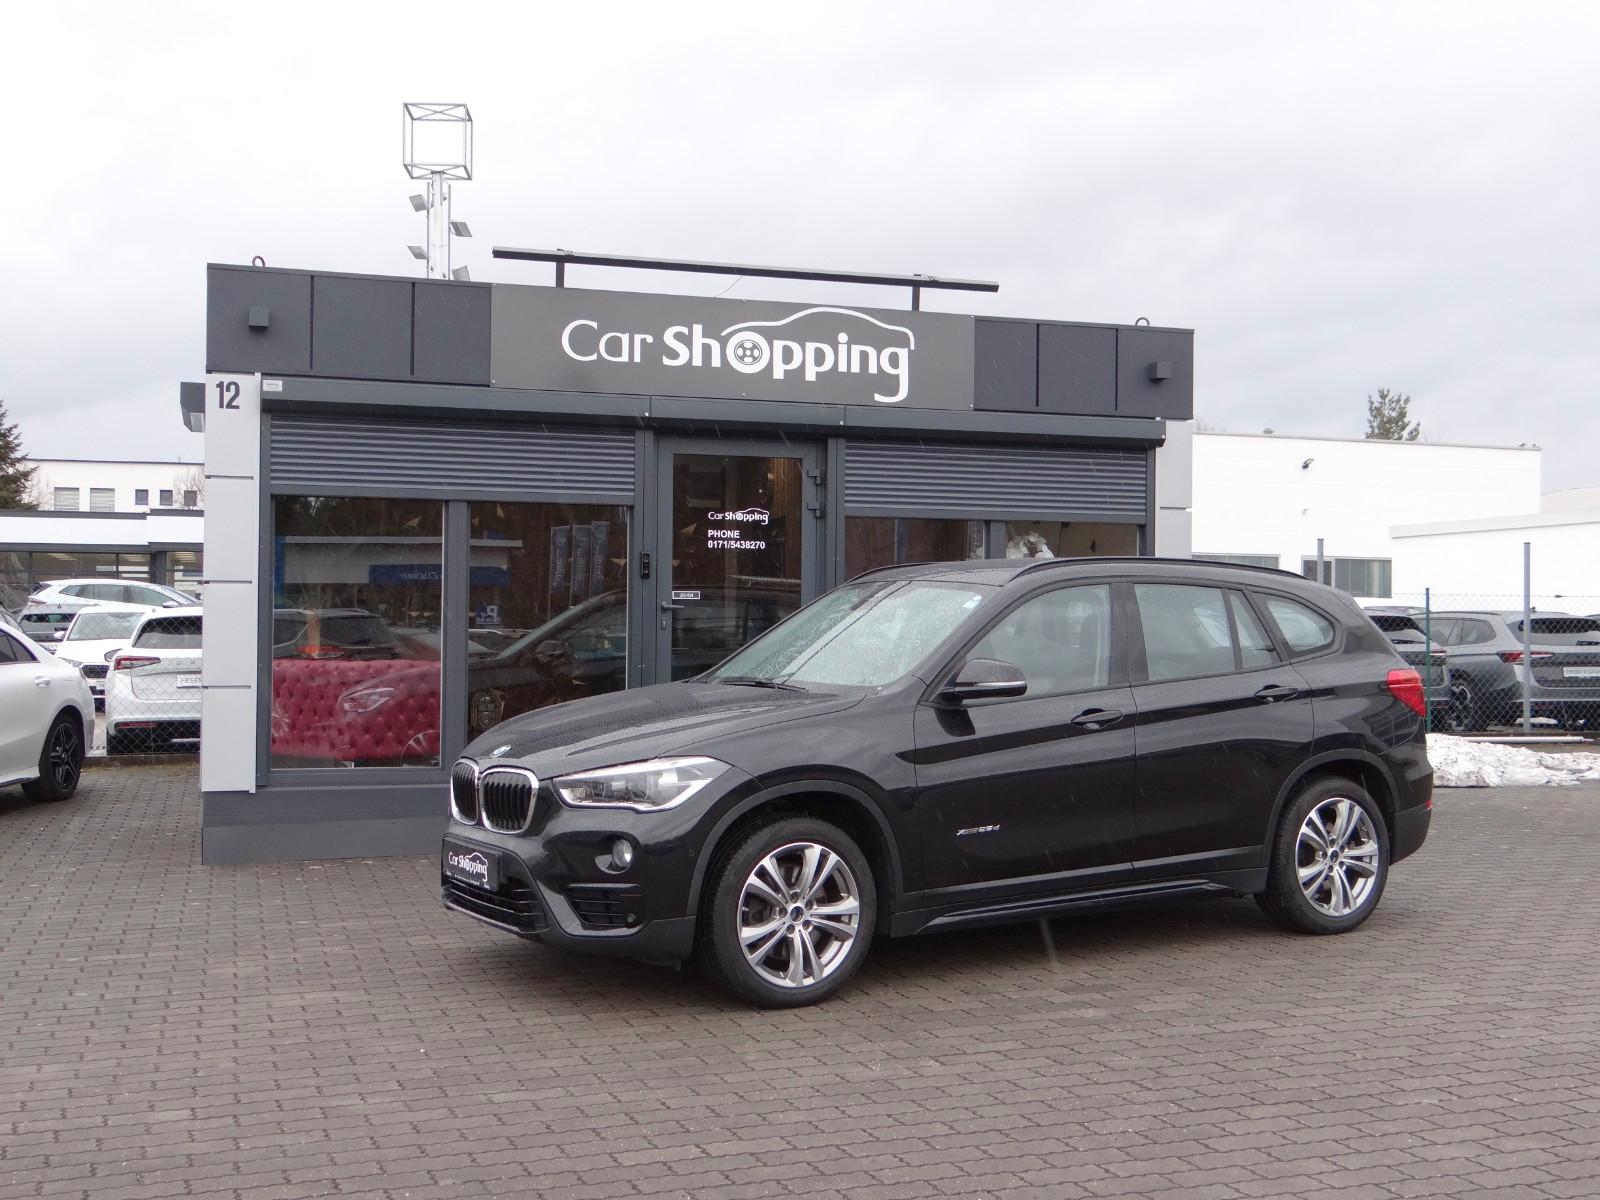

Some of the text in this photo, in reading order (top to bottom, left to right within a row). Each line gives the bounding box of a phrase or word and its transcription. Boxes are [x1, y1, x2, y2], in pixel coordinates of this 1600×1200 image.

[561, 319, 913, 403] Car Shopping
[215, 380, 241, 410] 12
[708, 510, 769, 526] Car Shopping
[707, 529, 740, 539] PHONE
[707, 540, 766, 550] 0171/5438270
[448, 852, 459, 866] Car
[459, 855, 488, 882] Shopping
